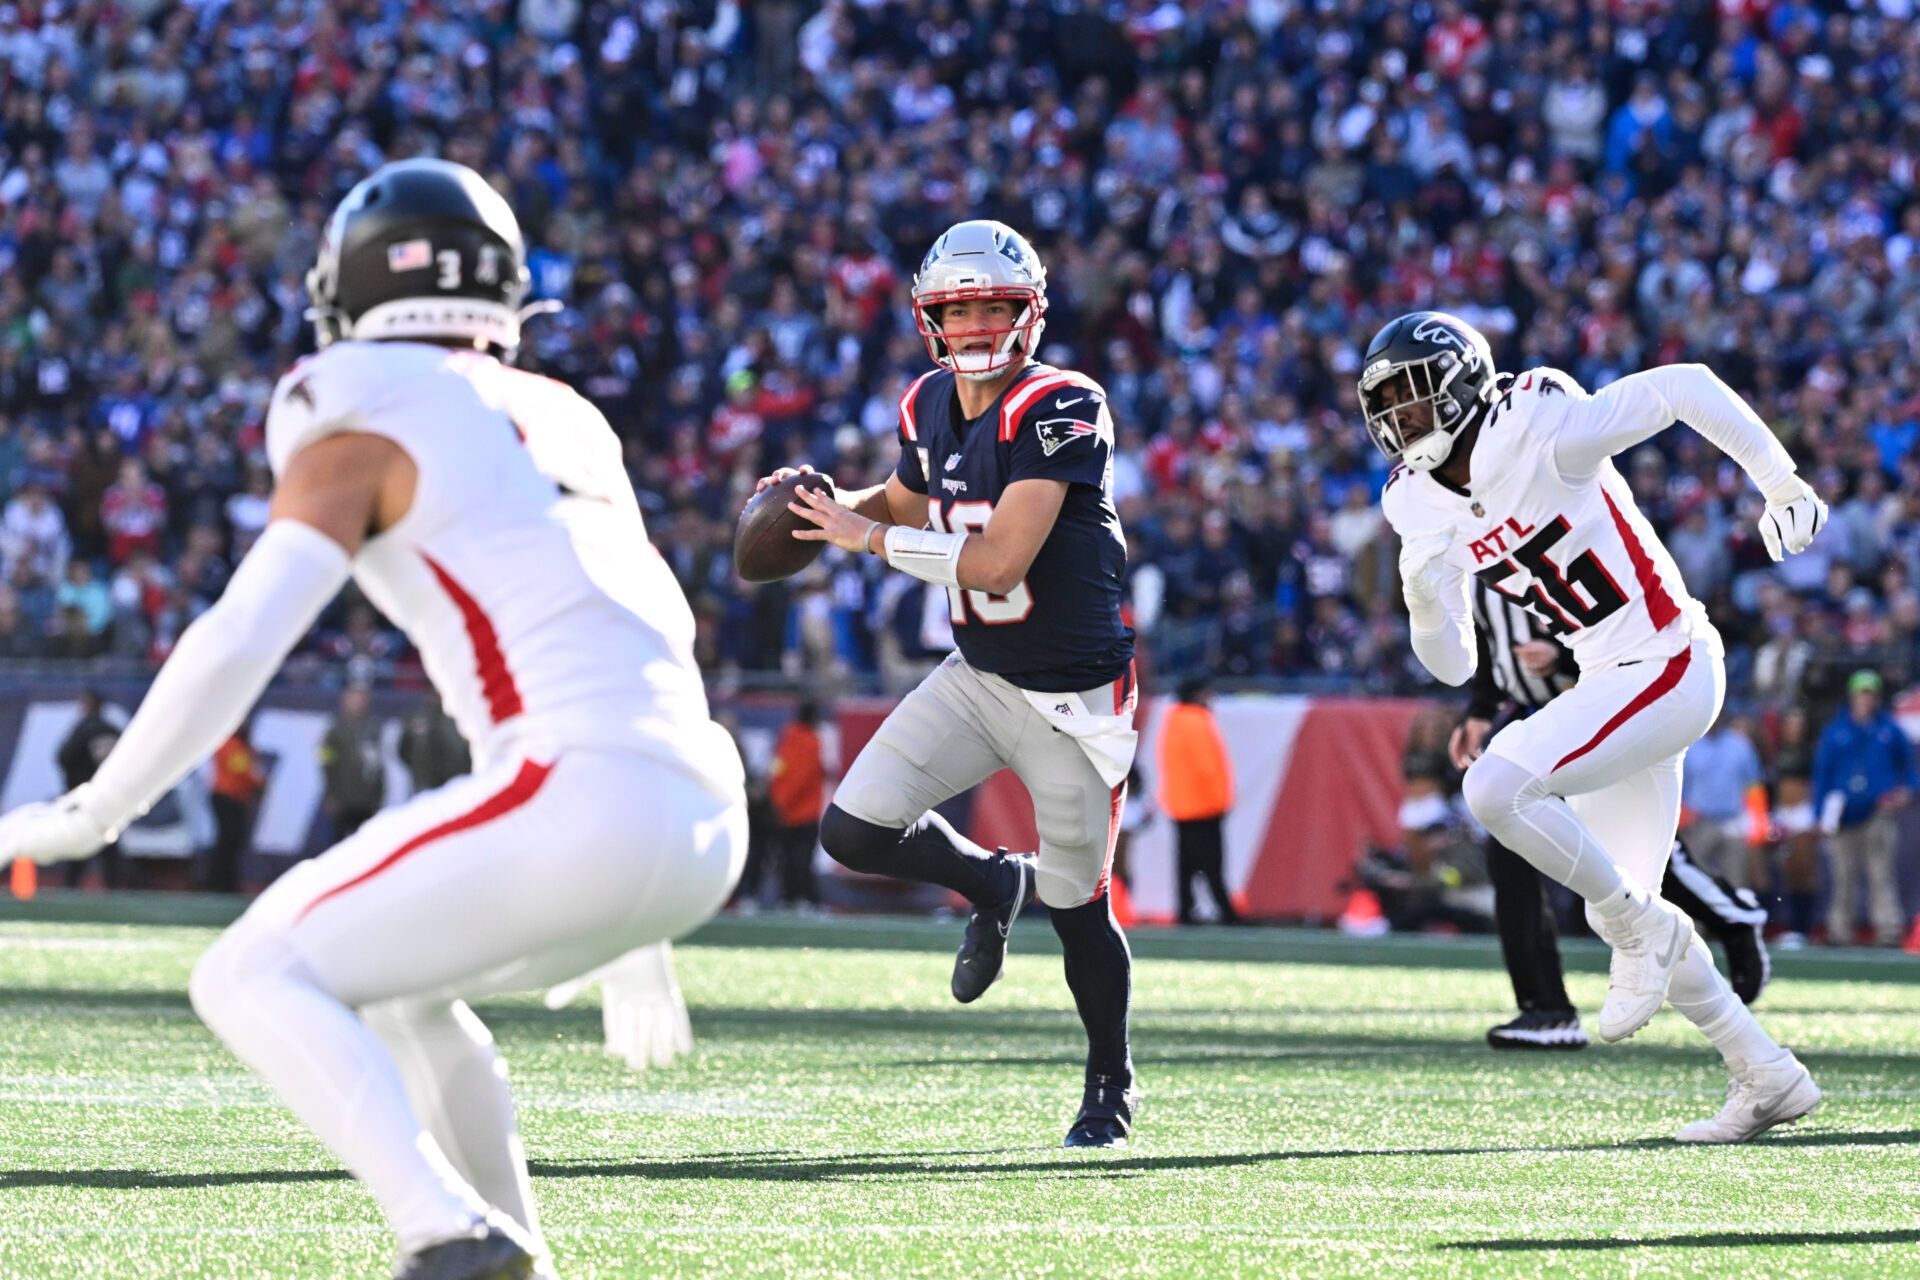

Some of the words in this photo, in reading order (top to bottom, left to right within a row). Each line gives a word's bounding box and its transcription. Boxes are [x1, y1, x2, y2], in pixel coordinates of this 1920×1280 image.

[435, 250, 462, 289] 3
[1468, 516, 1536, 564] ATL
[1473, 513, 1631, 637] 56
